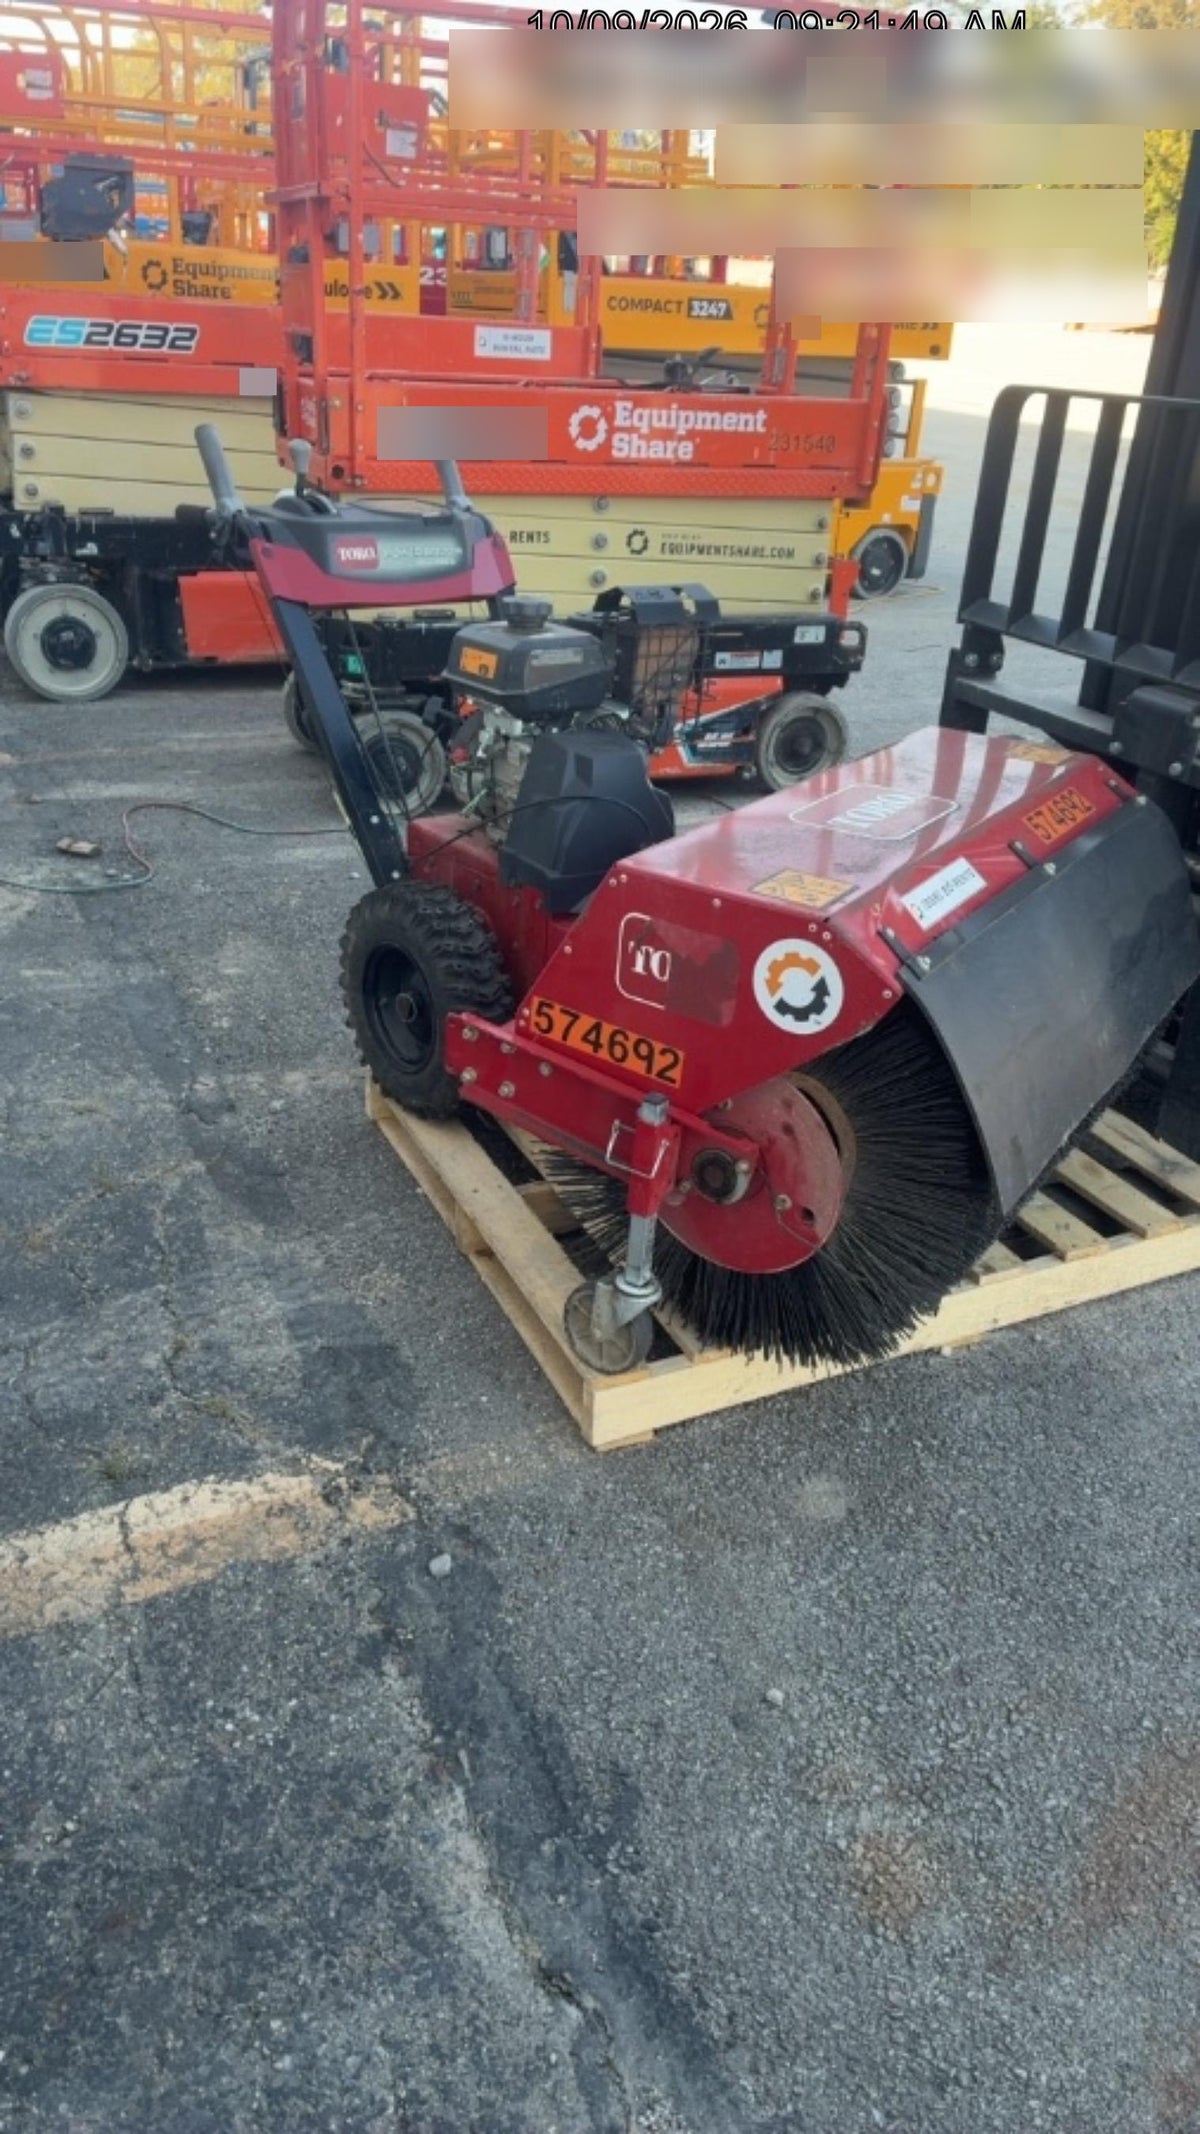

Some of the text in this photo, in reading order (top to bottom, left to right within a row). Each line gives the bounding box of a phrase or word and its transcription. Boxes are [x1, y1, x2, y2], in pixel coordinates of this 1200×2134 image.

[172, 279, 231, 299] Share
[607, 296, 728, 318] COMPACT 3247
[26, 317, 198, 353] ES2632
[613, 400, 768, 435] Equipment
[610, 431, 694, 461] Share
[338, 546, 376, 561] TORO
[661, 541, 796, 560] EQUIPMENTSHARE.COM
[627, 940, 672, 983] TO
[533, 1000, 681, 1085] 574692
